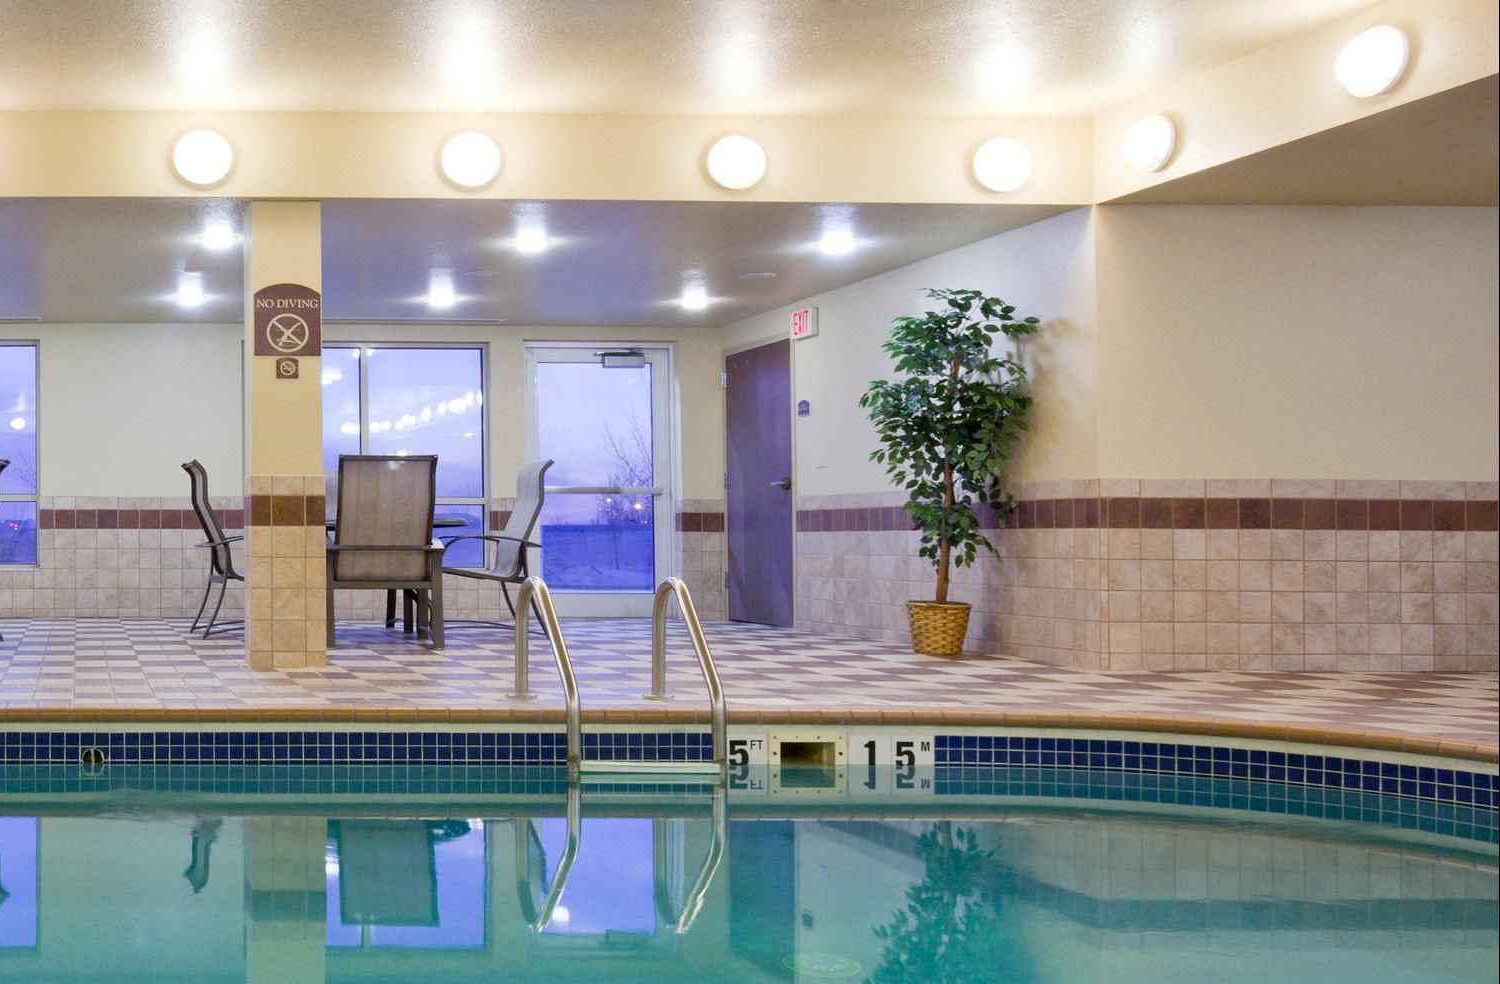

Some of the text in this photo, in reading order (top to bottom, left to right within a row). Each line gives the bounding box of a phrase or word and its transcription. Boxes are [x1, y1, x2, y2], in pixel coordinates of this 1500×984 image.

[256, 299, 318, 309] NO DIVING
[794, 309, 809, 336] EXIT
[729, 740, 764, 765] 5 FT
[921, 741, 930, 751] M
